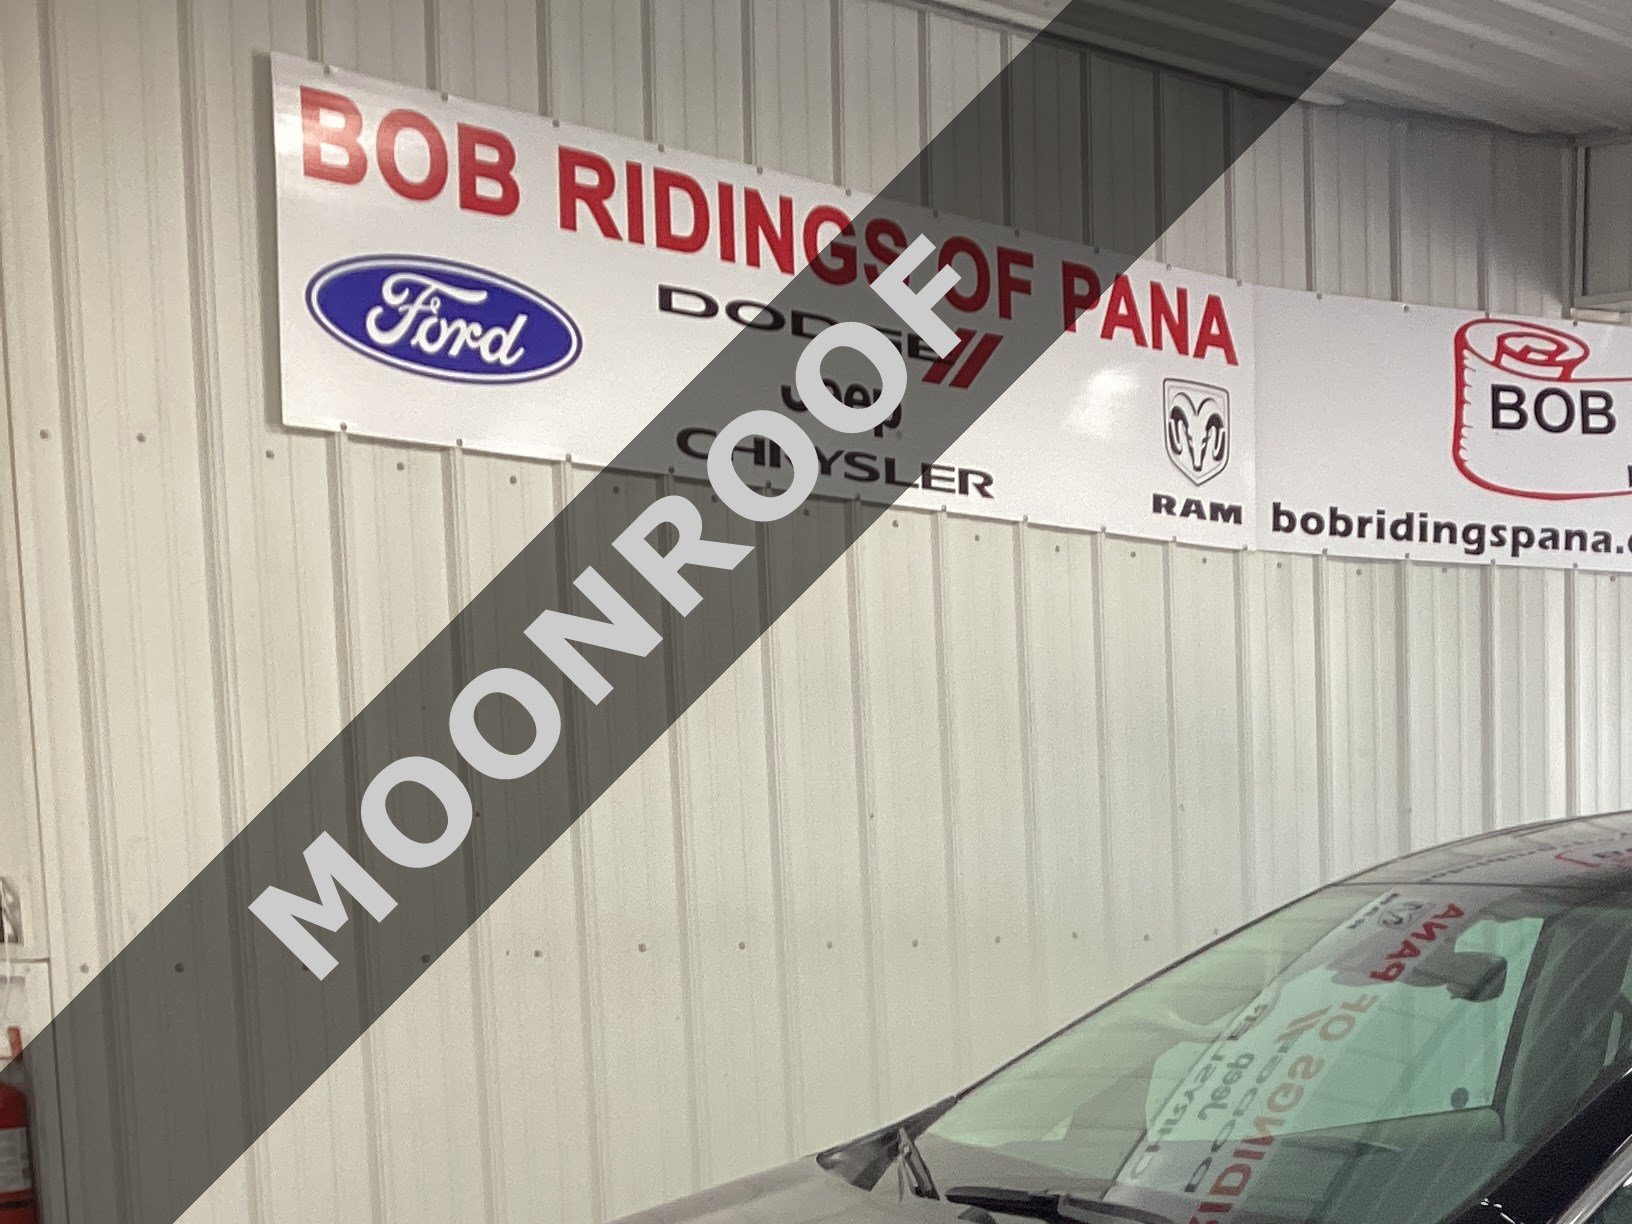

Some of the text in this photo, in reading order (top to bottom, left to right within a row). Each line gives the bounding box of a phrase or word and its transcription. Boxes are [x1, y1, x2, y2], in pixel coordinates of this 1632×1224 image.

[300, 86, 1238, 365] BOB RIDINGS OF PANA
[365, 272, 527, 367] Ford
[1489, 385, 1616, 435] BOB
[1152, 493, 1242, 525] RAM
